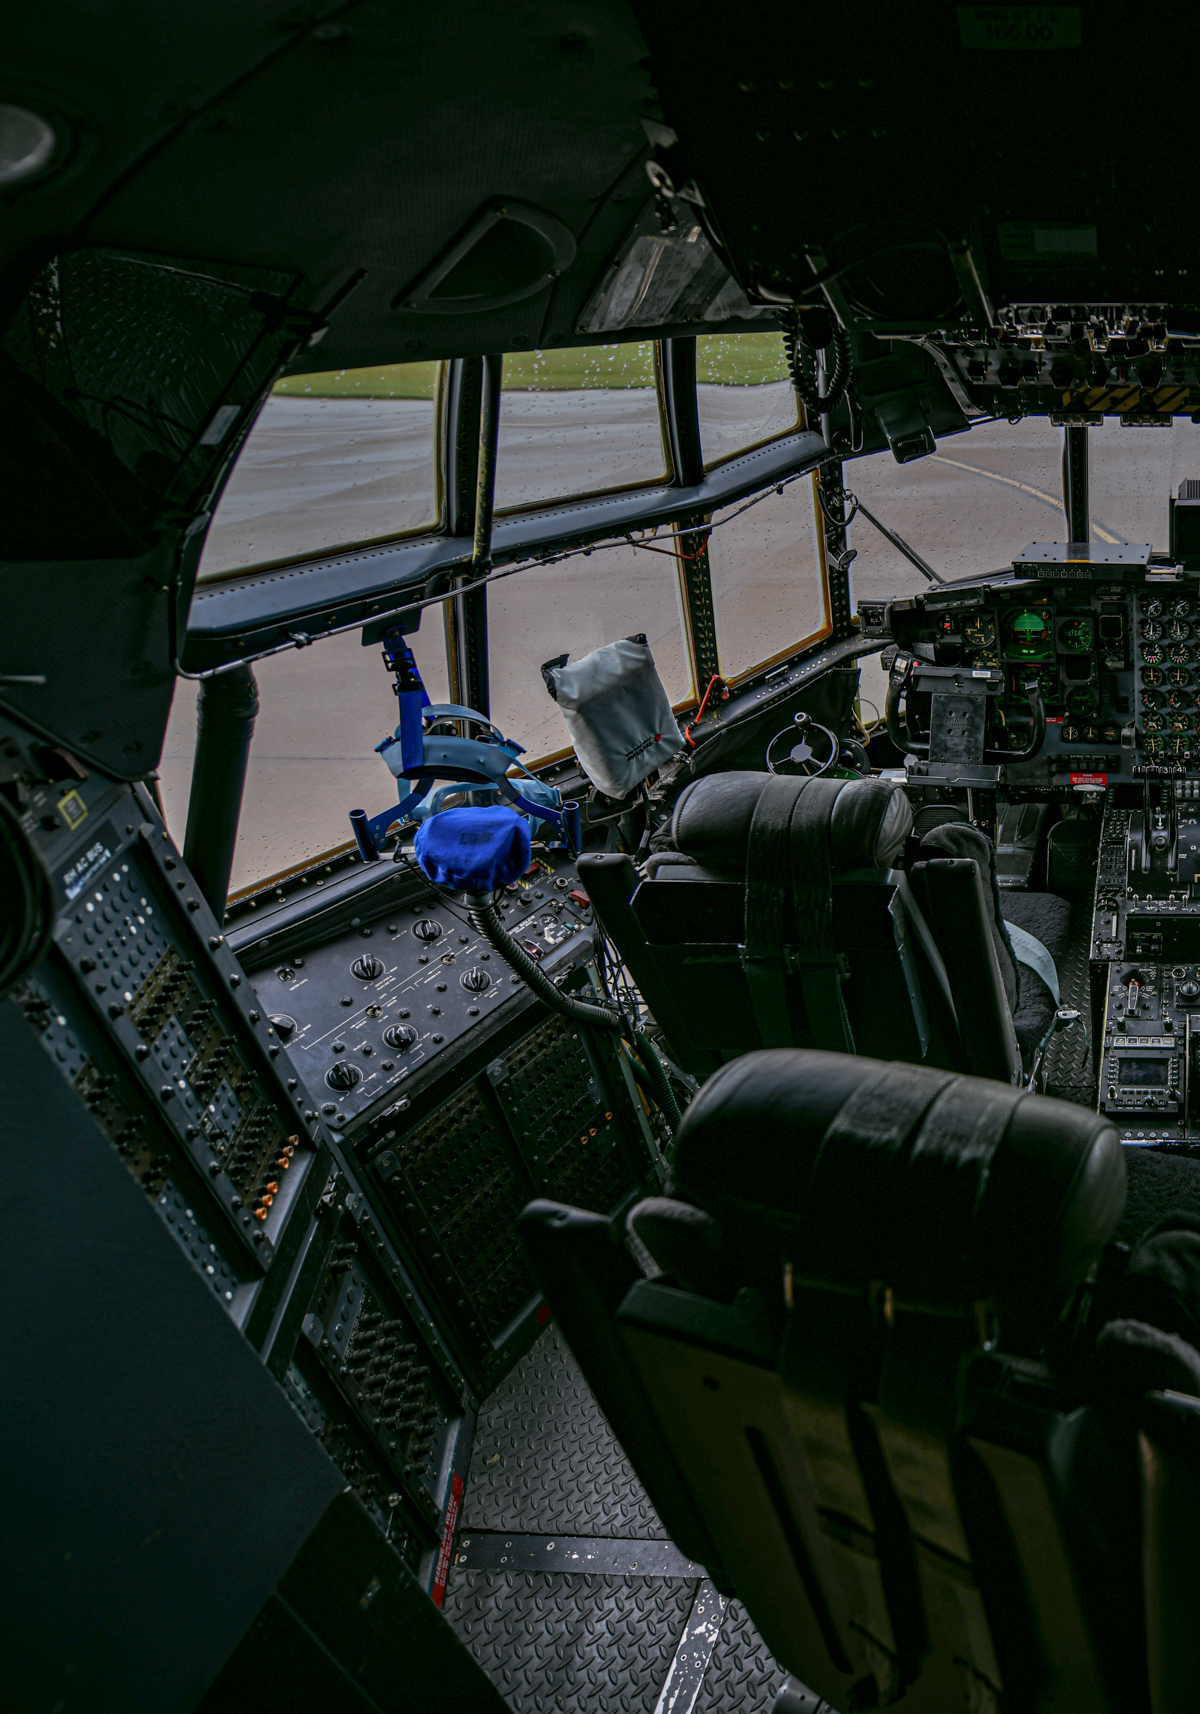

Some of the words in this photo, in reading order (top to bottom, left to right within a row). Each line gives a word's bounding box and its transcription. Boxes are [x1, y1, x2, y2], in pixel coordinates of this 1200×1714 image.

[75, 857, 88, 873] AC
[85, 841, 104, 862] BUS
[434, 1527, 448, 1583] WARNING-HIGH
[445, 1491, 455, 1524] VOLTAGE
